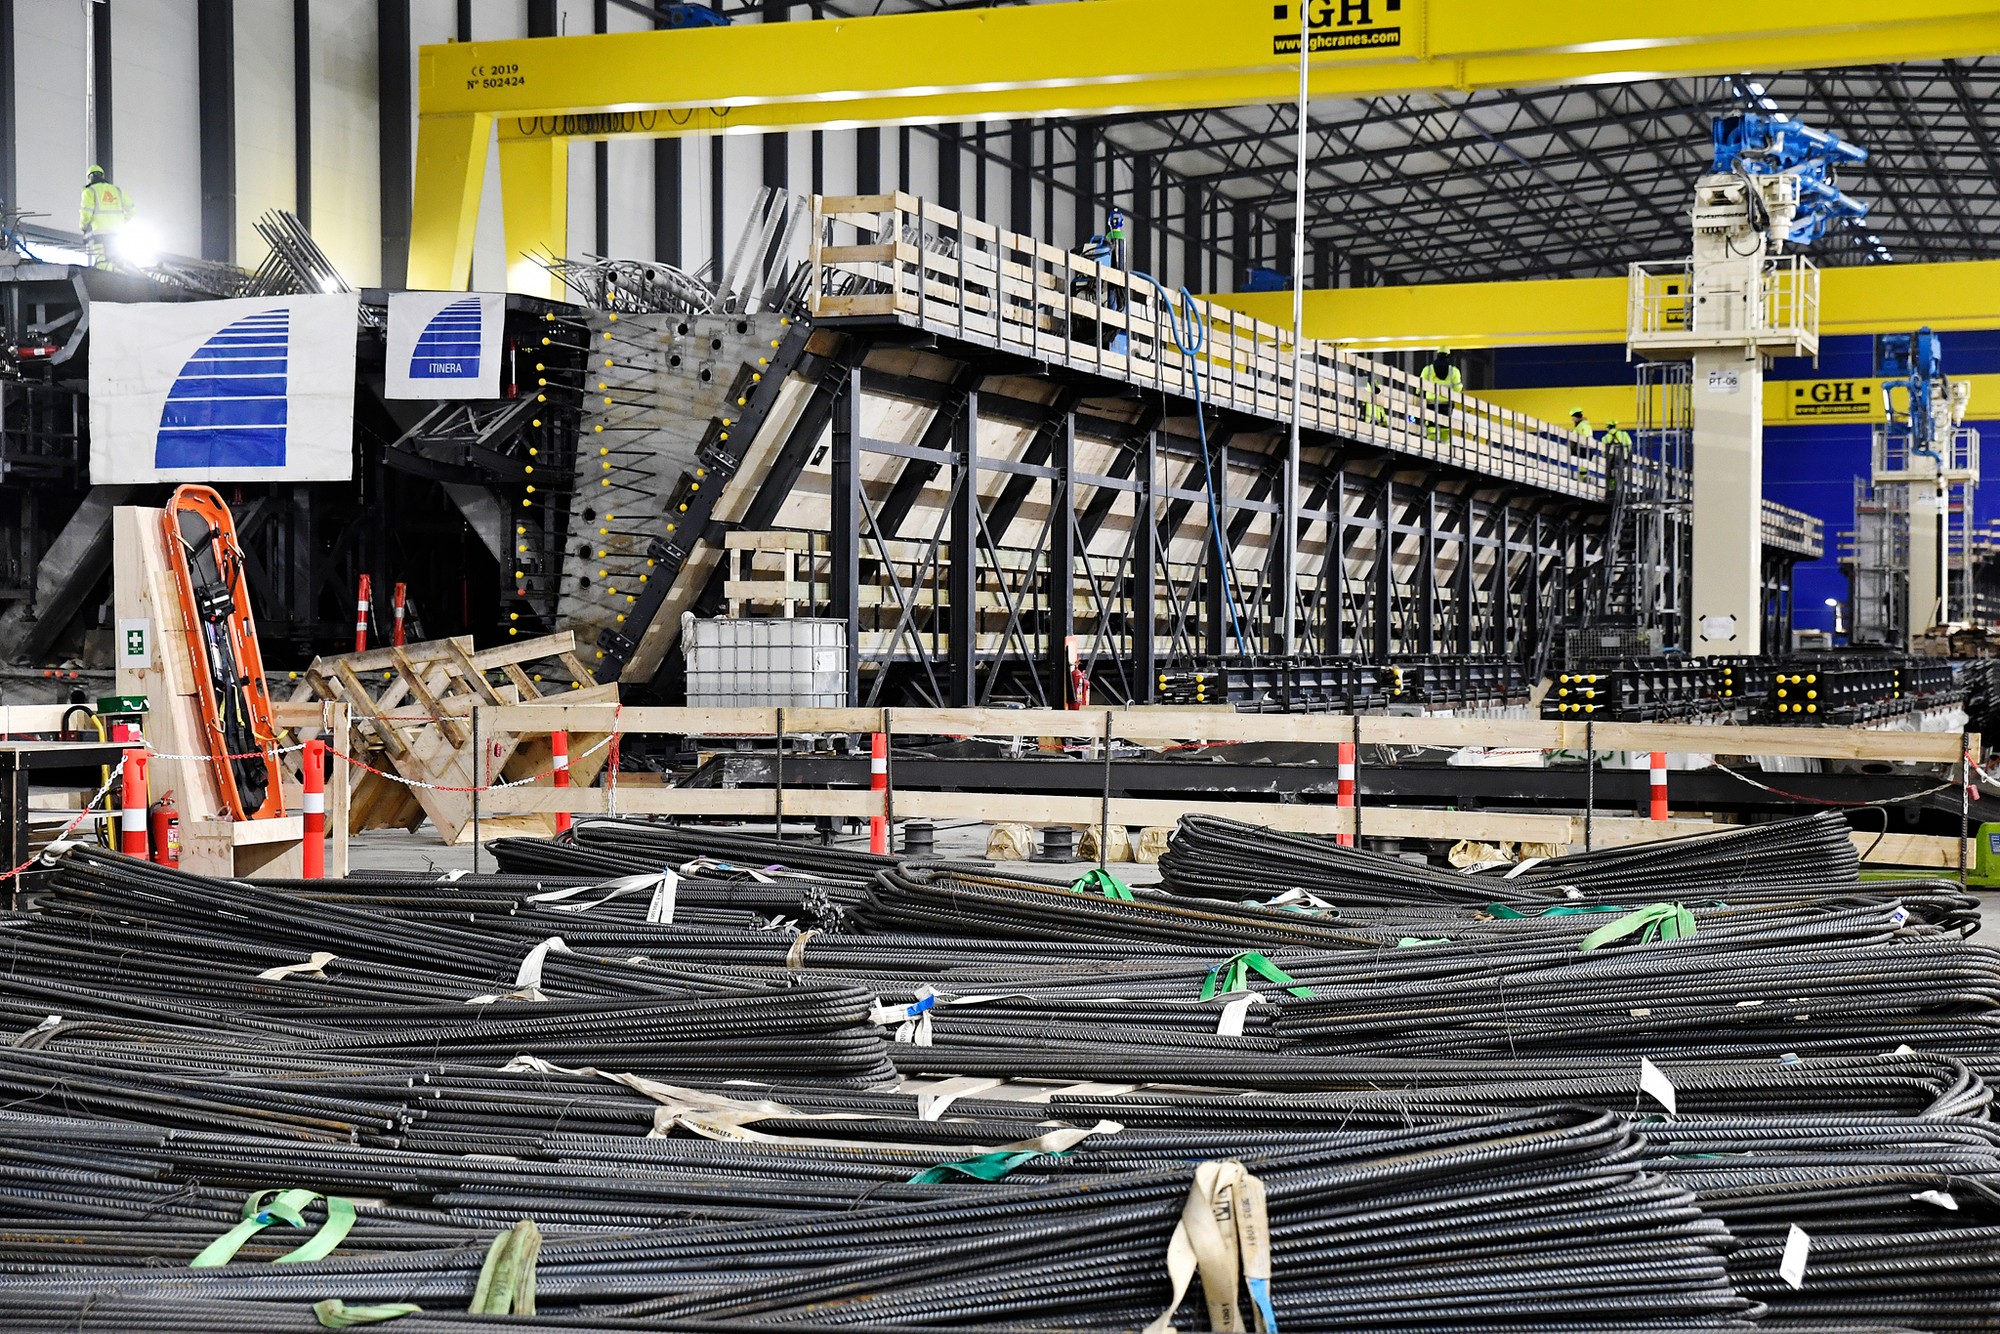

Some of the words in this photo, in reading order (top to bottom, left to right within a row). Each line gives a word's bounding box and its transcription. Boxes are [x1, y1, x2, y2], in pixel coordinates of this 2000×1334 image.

[1300, 0, 1373, 28] GH
[1275, 32, 1399, 51] wwwghcranes.com
[491, 64, 519, 75] 2019
[483, 76, 525, 89] 502424
[429, 363, 462, 373] ITINERA
[1709, 377, 1738, 386] PT-06
[1811, 382, 1854, 402] GH
[1222, 1303, 1231, 1325] 1001
